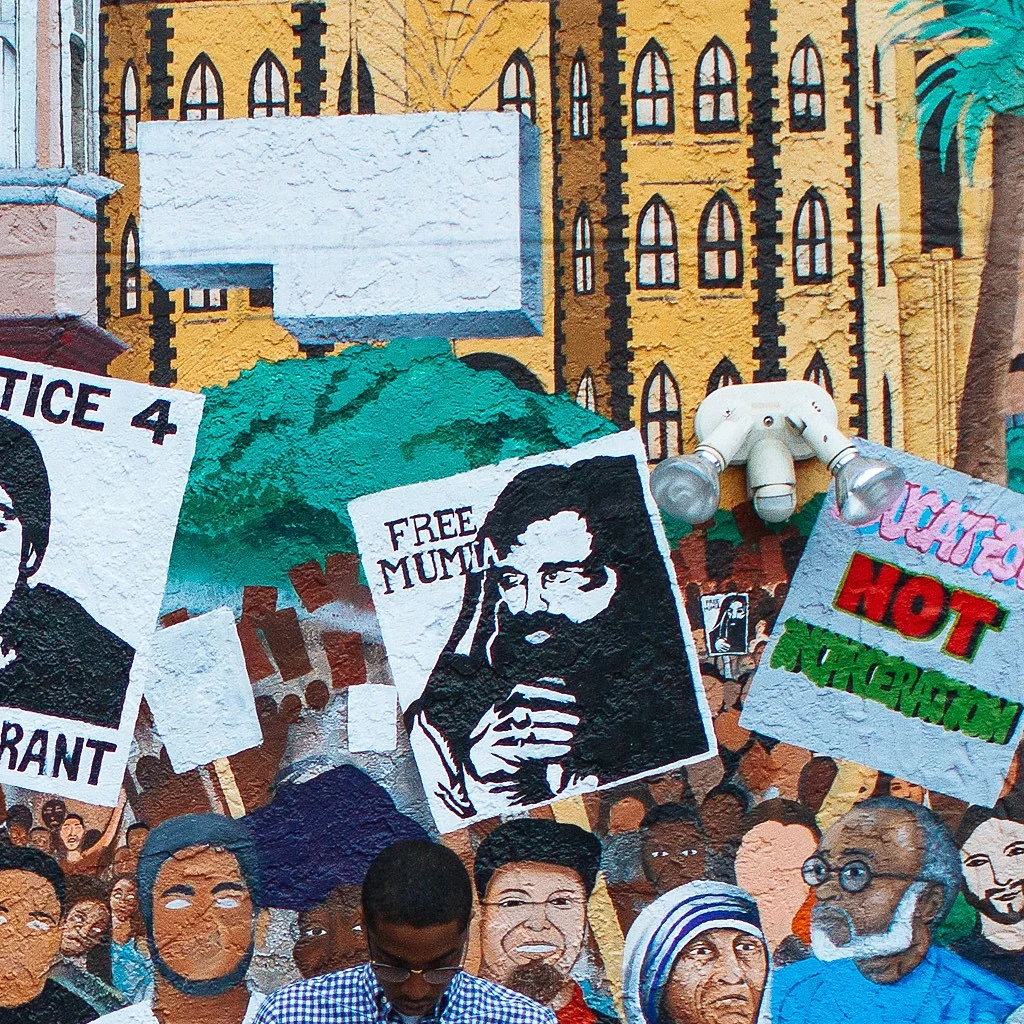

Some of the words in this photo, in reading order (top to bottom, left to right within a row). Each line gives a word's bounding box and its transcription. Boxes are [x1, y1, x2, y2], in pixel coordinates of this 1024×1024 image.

[131, 400, 177, 445] 4
[384, 506, 477, 551] FREE
[831, 480, 1024, 590] UCATIO
[377, 537, 498, 595] MUMIA
[832, 551, 1009, 663] NOT
